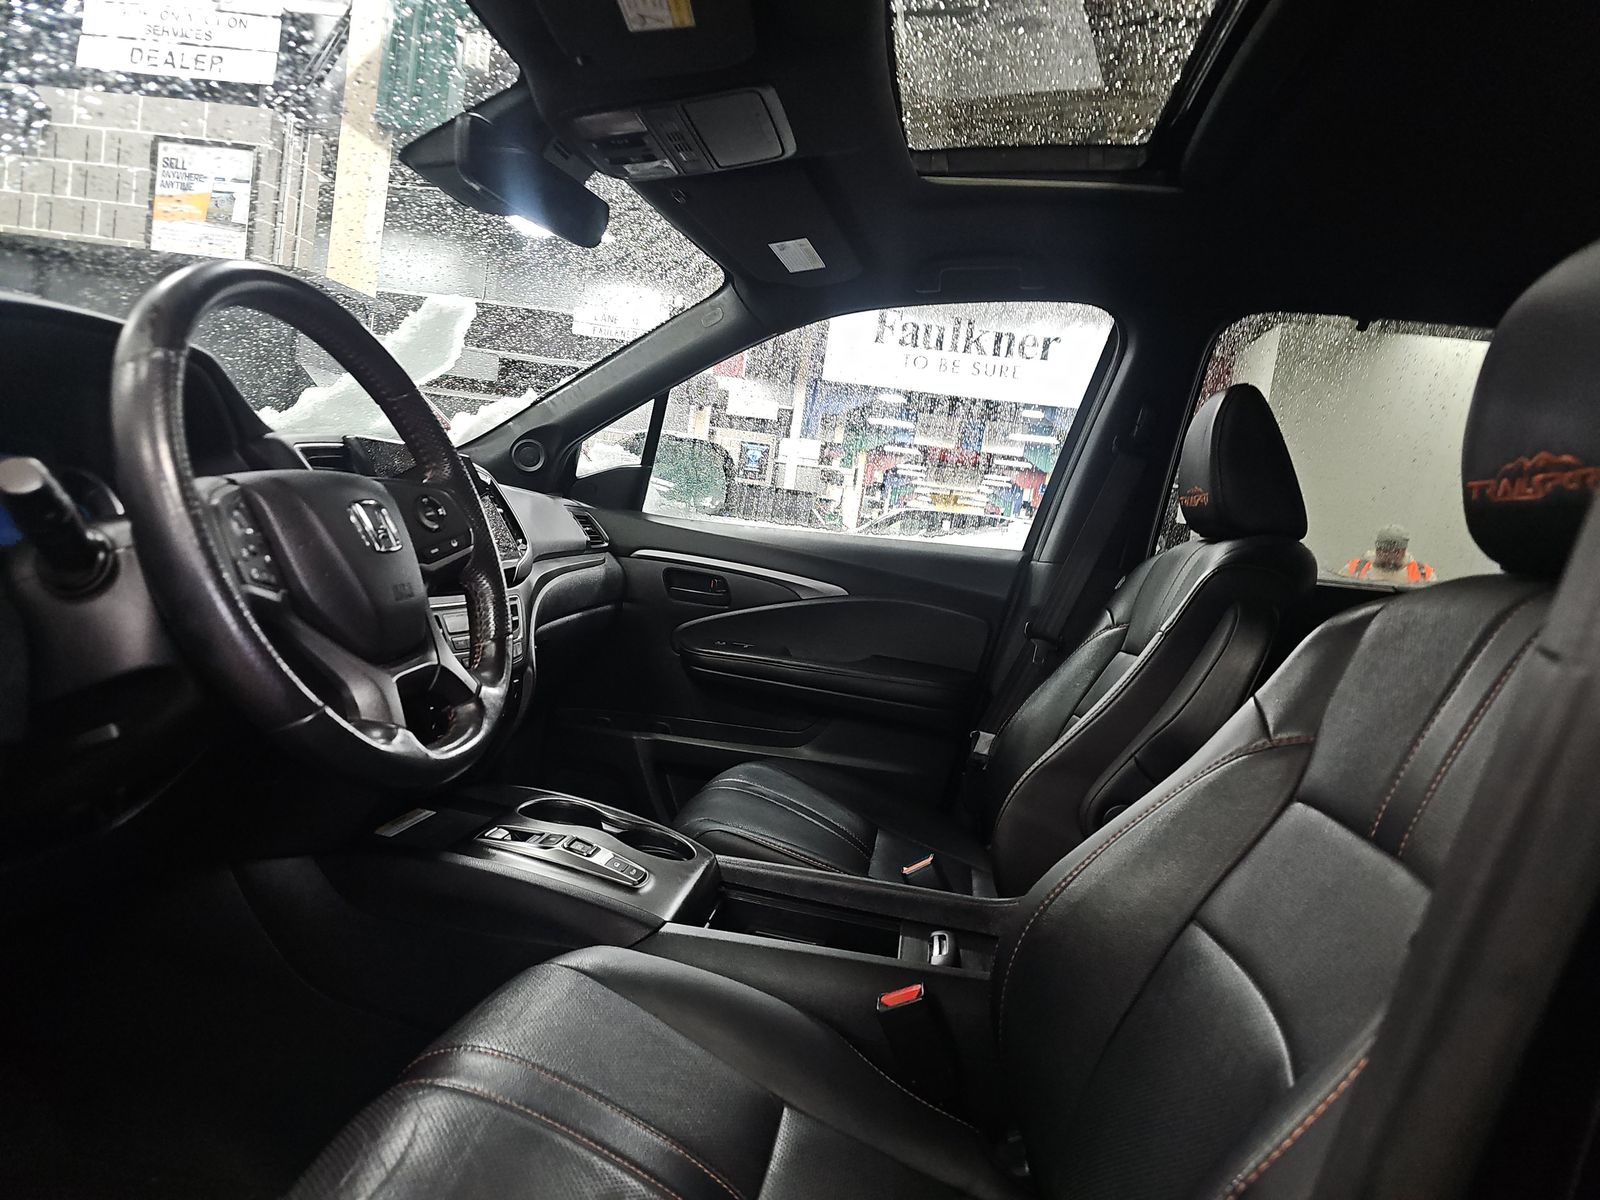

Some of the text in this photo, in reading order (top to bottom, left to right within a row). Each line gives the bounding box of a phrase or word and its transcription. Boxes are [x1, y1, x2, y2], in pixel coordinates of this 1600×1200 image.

[130, 47, 223, 73] DEALER
[162, 157, 187, 170] SELL
[874, 309, 1062, 361] Faulkner
[904, 353, 1021, 380] TO BE SURE
